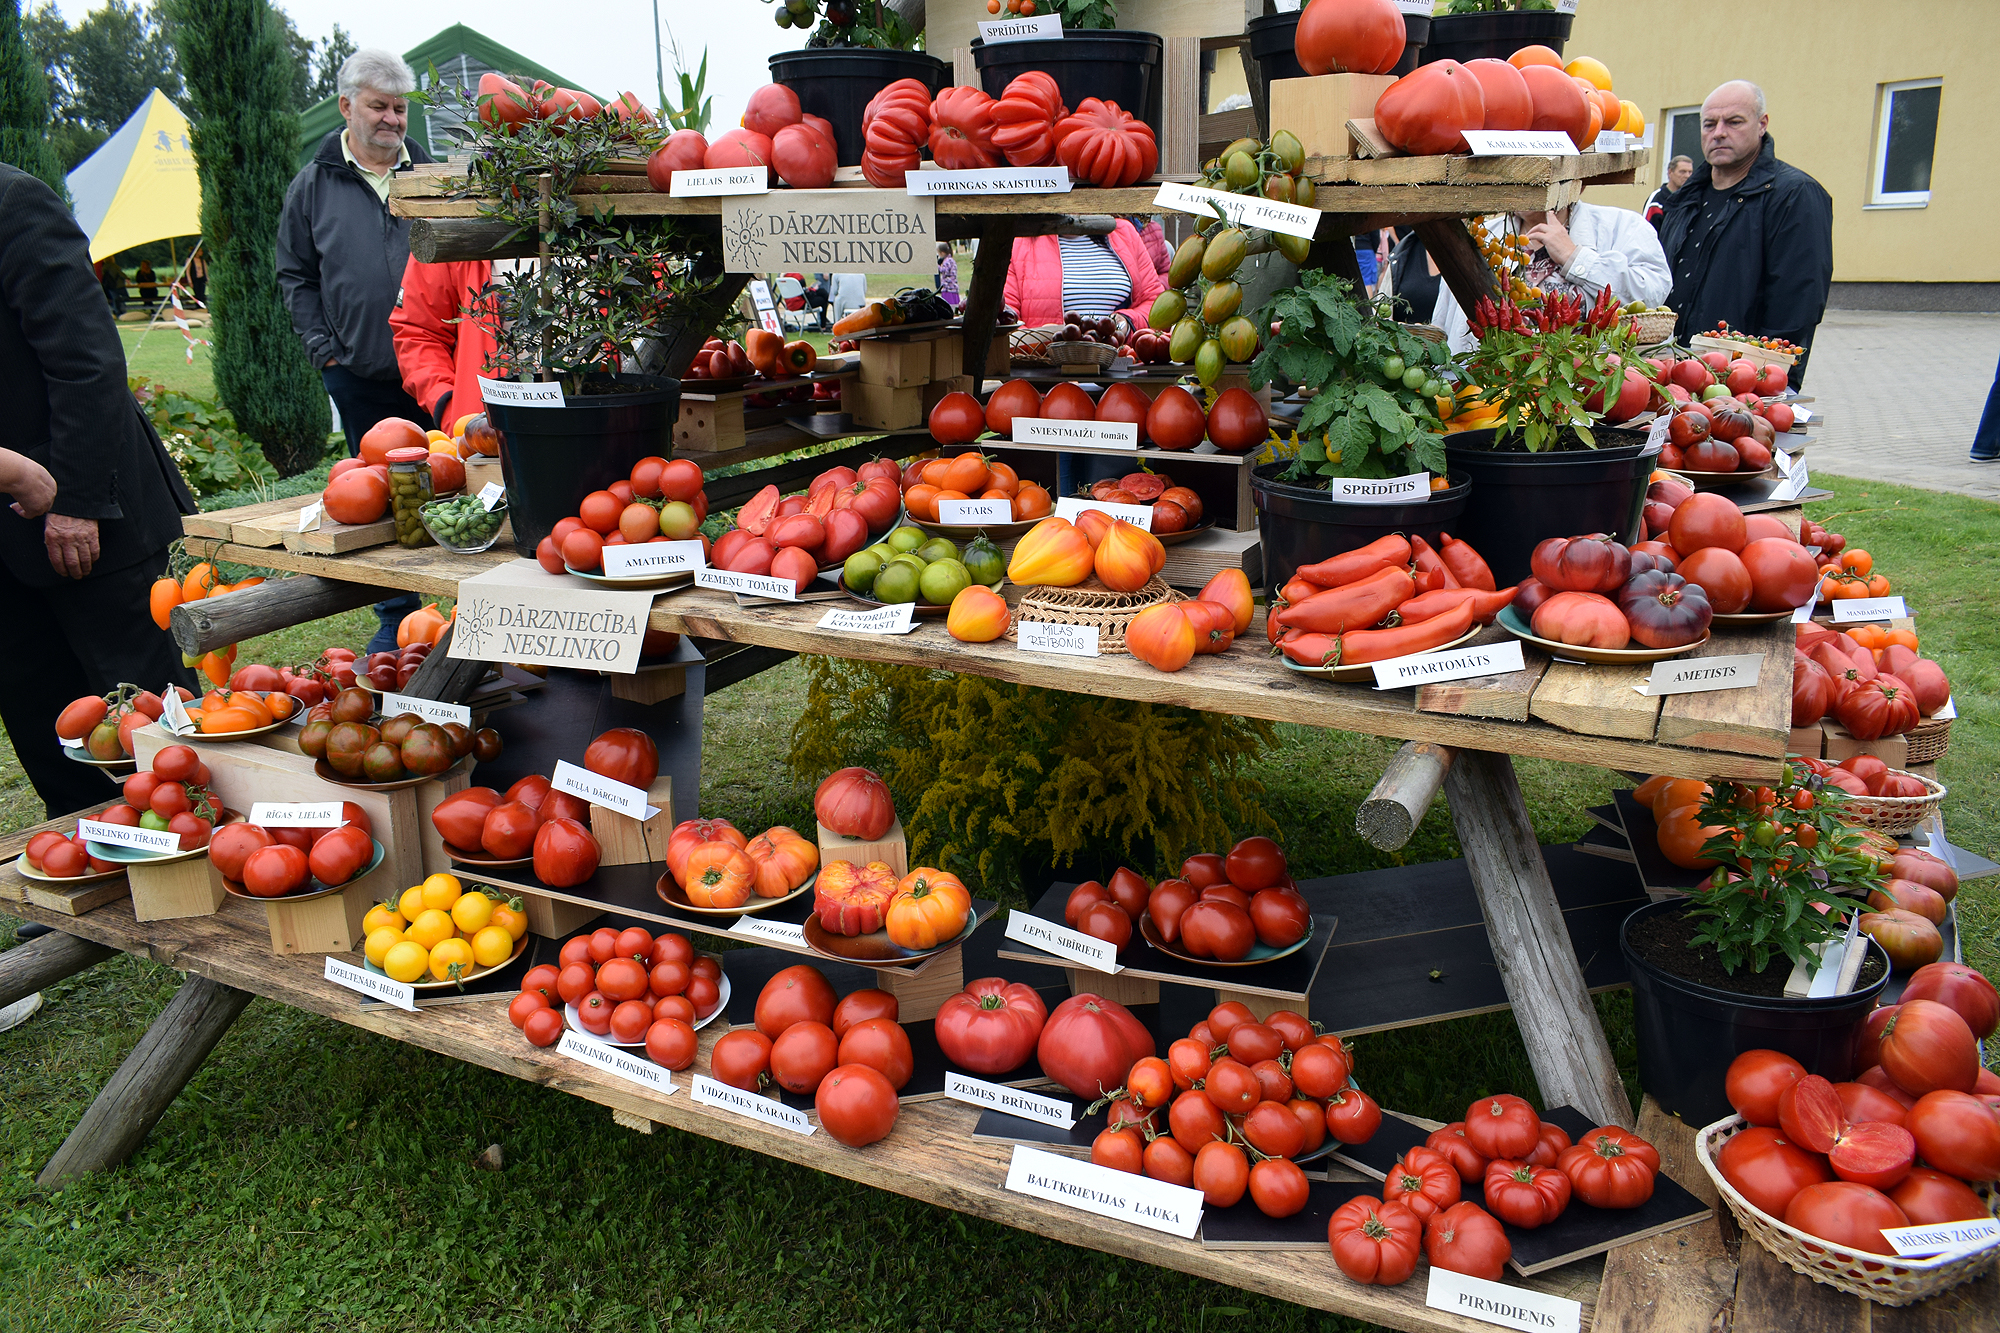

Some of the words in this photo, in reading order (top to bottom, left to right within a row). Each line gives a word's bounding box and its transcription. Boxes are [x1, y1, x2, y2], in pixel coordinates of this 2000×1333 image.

[987, 23, 1039, 37] SPRĪDĪTIS
[1486, 140, 1528, 149] KARALIS
[1531, 139, 1565, 149] KĀRLIS
[687, 177, 723, 187] LIELAIS
[729, 174, 755, 184] ROZĀ
[927, 181, 988, 191] LOTRINGAS
[992, 179, 1058, 190] SKAISTULES
[768, 208, 927, 236] DĀRZNIECĪBA
[1255, 206, 1308, 225] TĪĢERIS
[781, 241, 914, 264] NESLINKO
[522, 391, 558, 400] BLACK
[1030, 426, 1096, 438] SVIESTMAIŽU
[1100, 432, 1129, 440] tomāts
[1342, 481, 1415, 495] SPRĪDĪTIS
[959, 506, 993, 515] STARS
[625, 555, 685, 568] AMATIERIS
[701, 573, 743, 588] ZEMEŅU
[747, 580, 789, 594] TOMĀTS
[498, 604, 638, 635] DĀRZNIECĪBA
[830, 620, 895, 630] KONTRASTI
[502, 633, 621, 661] NESLINKO
[1398, 655, 1490, 677] PIPARTOMĀTS
[1673, 666, 1736, 682] AMETISTS
[396, 702, 424, 713] MELNĀ
[428, 708, 459, 719] ZEBRA
[592, 787, 629, 806] DĀRGUMI
[265, 810, 294, 819] RĪGAS
[298, 811, 332, 819] LIELAIS
[85, 826, 130, 841] NESLINKO
[133, 834, 171, 847] TĪRAINE
[751, 924, 804, 939] DIVKOLOR
[1023, 924, 1052, 941] LEPNĀ
[1057, 936, 1104, 959] SIBĪRIETE
[330, 966, 377, 990] DZELTENAIS
[379, 983, 405, 999] HELIO
[565, 1038, 613, 1064] NESLINKO
[616, 1058, 660, 1083] KONDĪNE
[701, 1085, 752, 1109] VIDZEMES
[756, 1103, 802, 1126] KARALIS
[953, 1082, 996, 1101] ZEMES
[1001, 1095, 1063, 1119] BRĪNUMS
[1027, 1173, 1126, 1208] BALTKRIEVIJAS
[1135, 1202, 1180, 1223] LAUKA
[1896, 1232, 1951, 1247] MĒNESS
[1458, 1292, 1556, 1327] PIRMDIENIS
